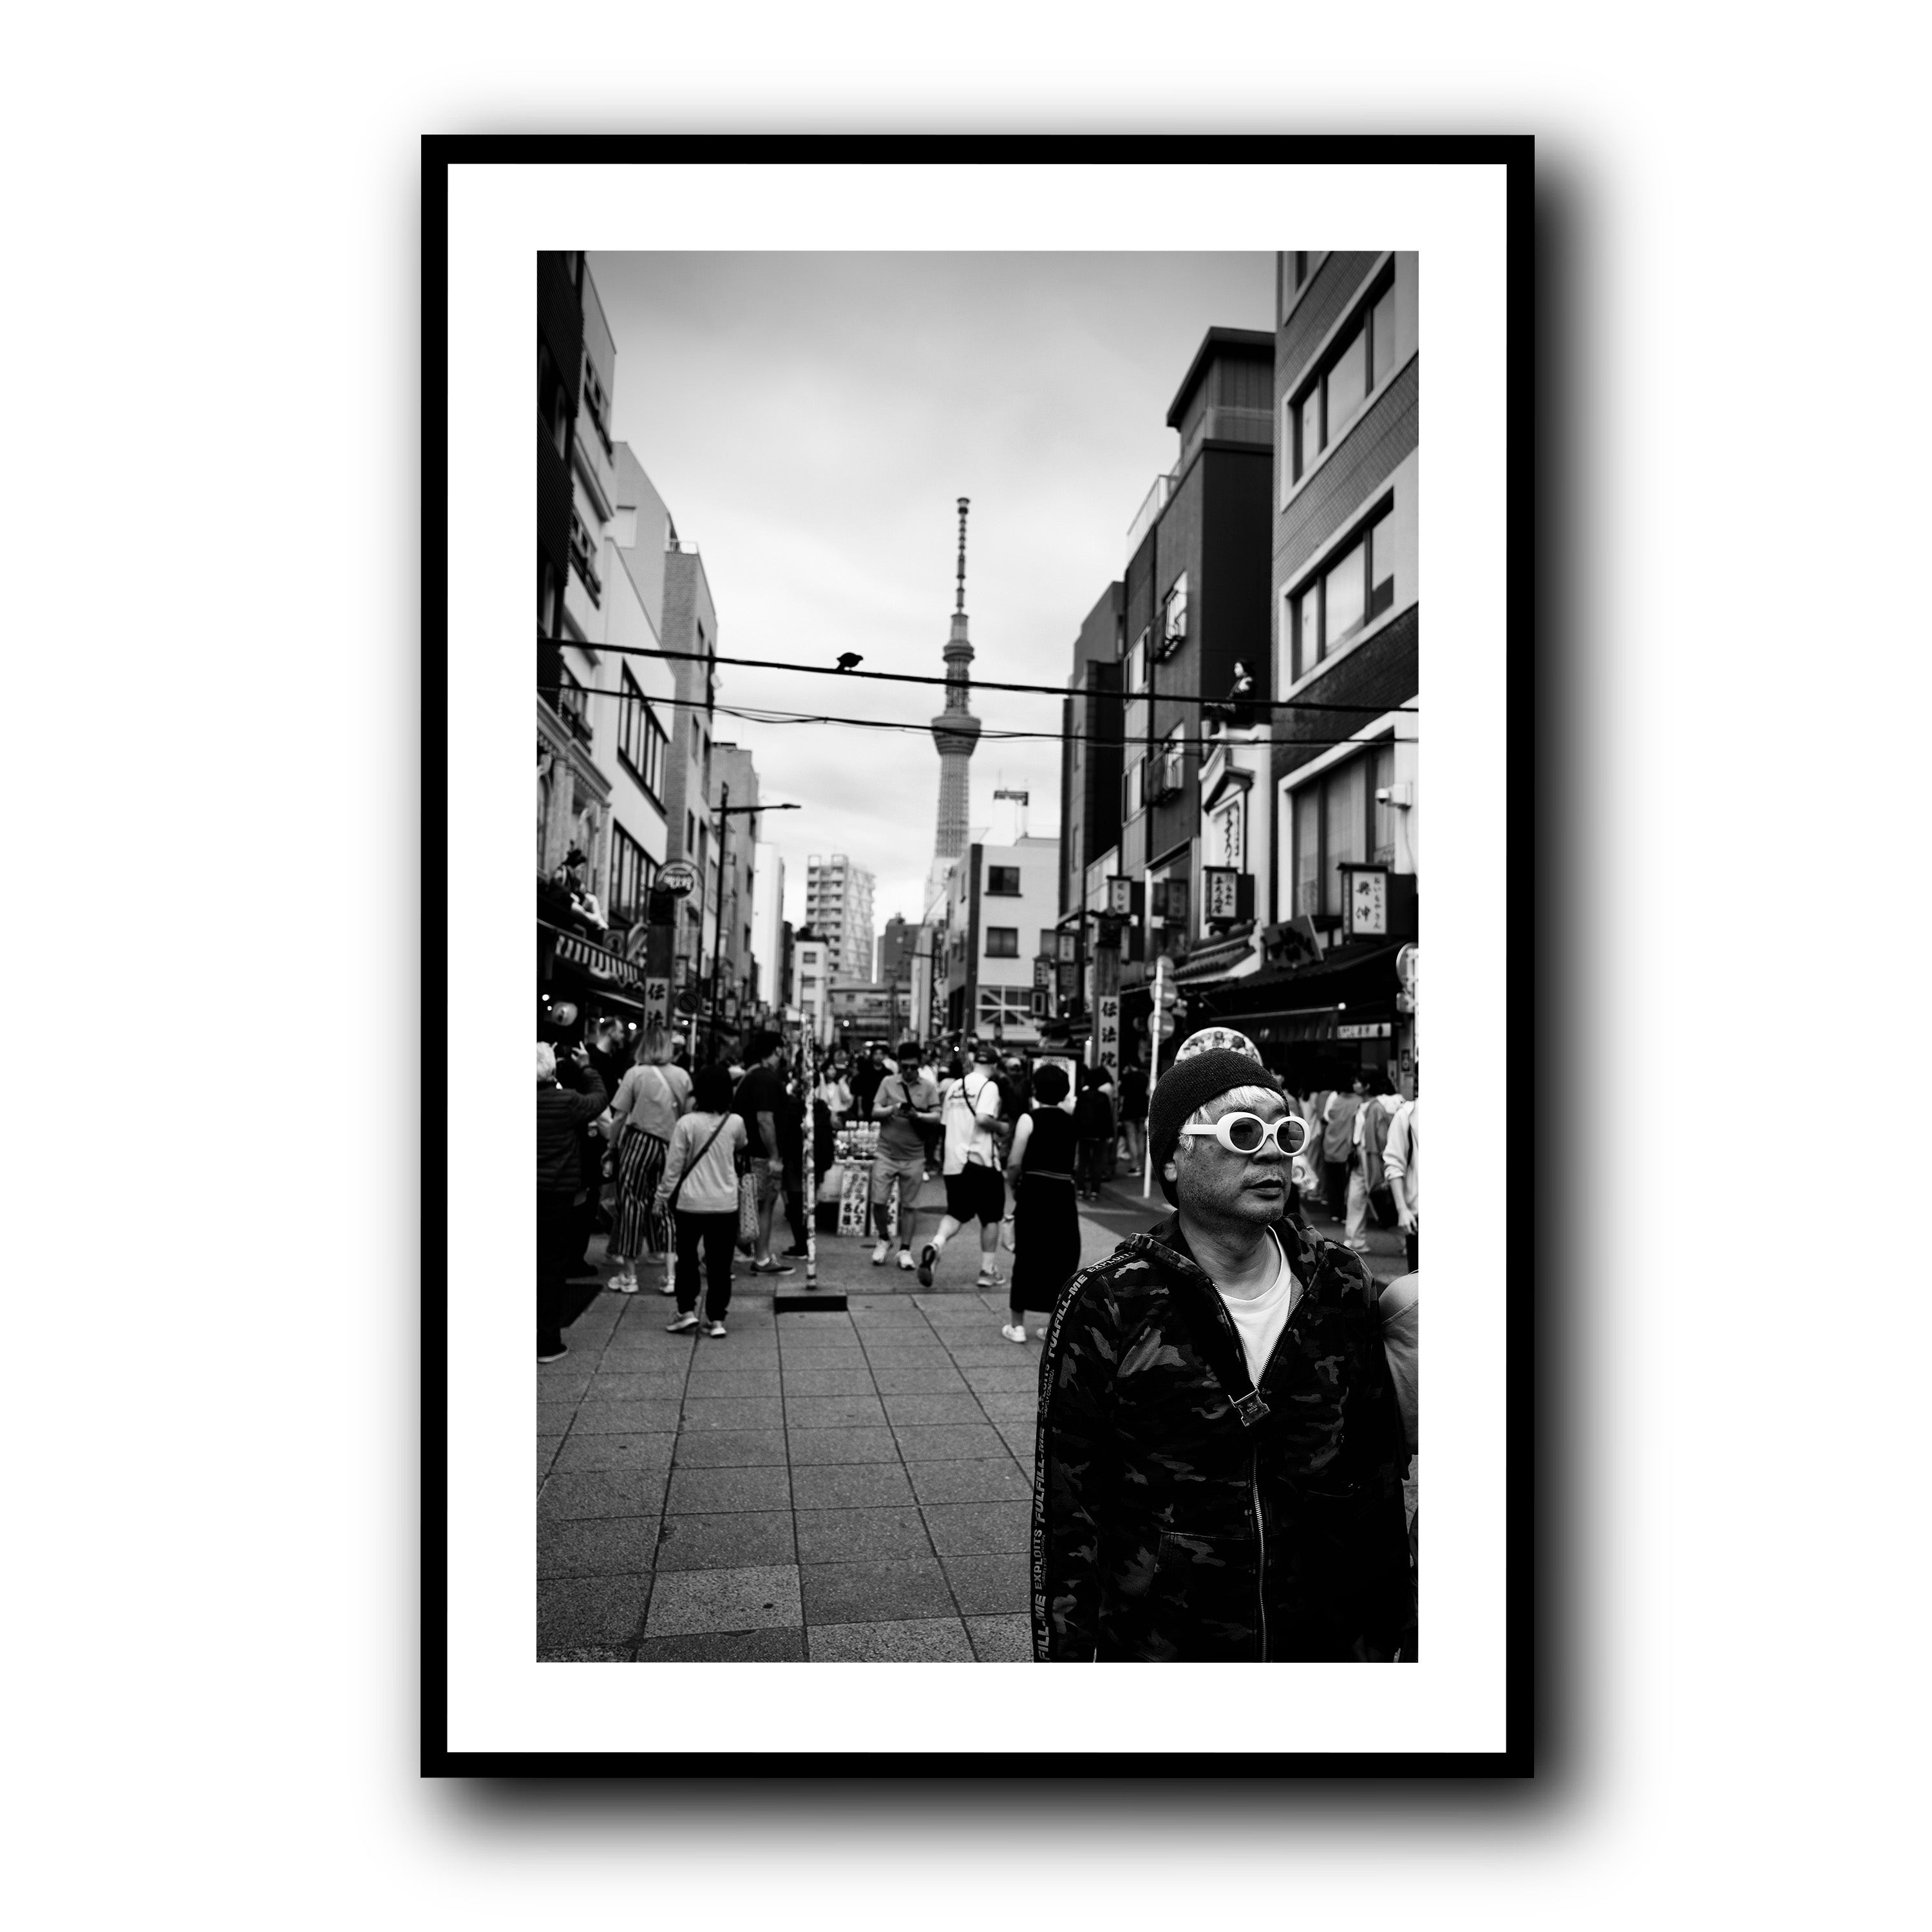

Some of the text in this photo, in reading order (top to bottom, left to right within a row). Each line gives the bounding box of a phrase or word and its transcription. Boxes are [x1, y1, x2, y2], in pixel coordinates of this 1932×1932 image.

[1101, 1001, 1118, 1068] 伝法院
[1048, 1274, 1088, 1358] FULFILL-ME
[1035, 1426, 1046, 1523] FULFILL-ME
[1034, 1530, 1043, 1590] EXPLOITS
